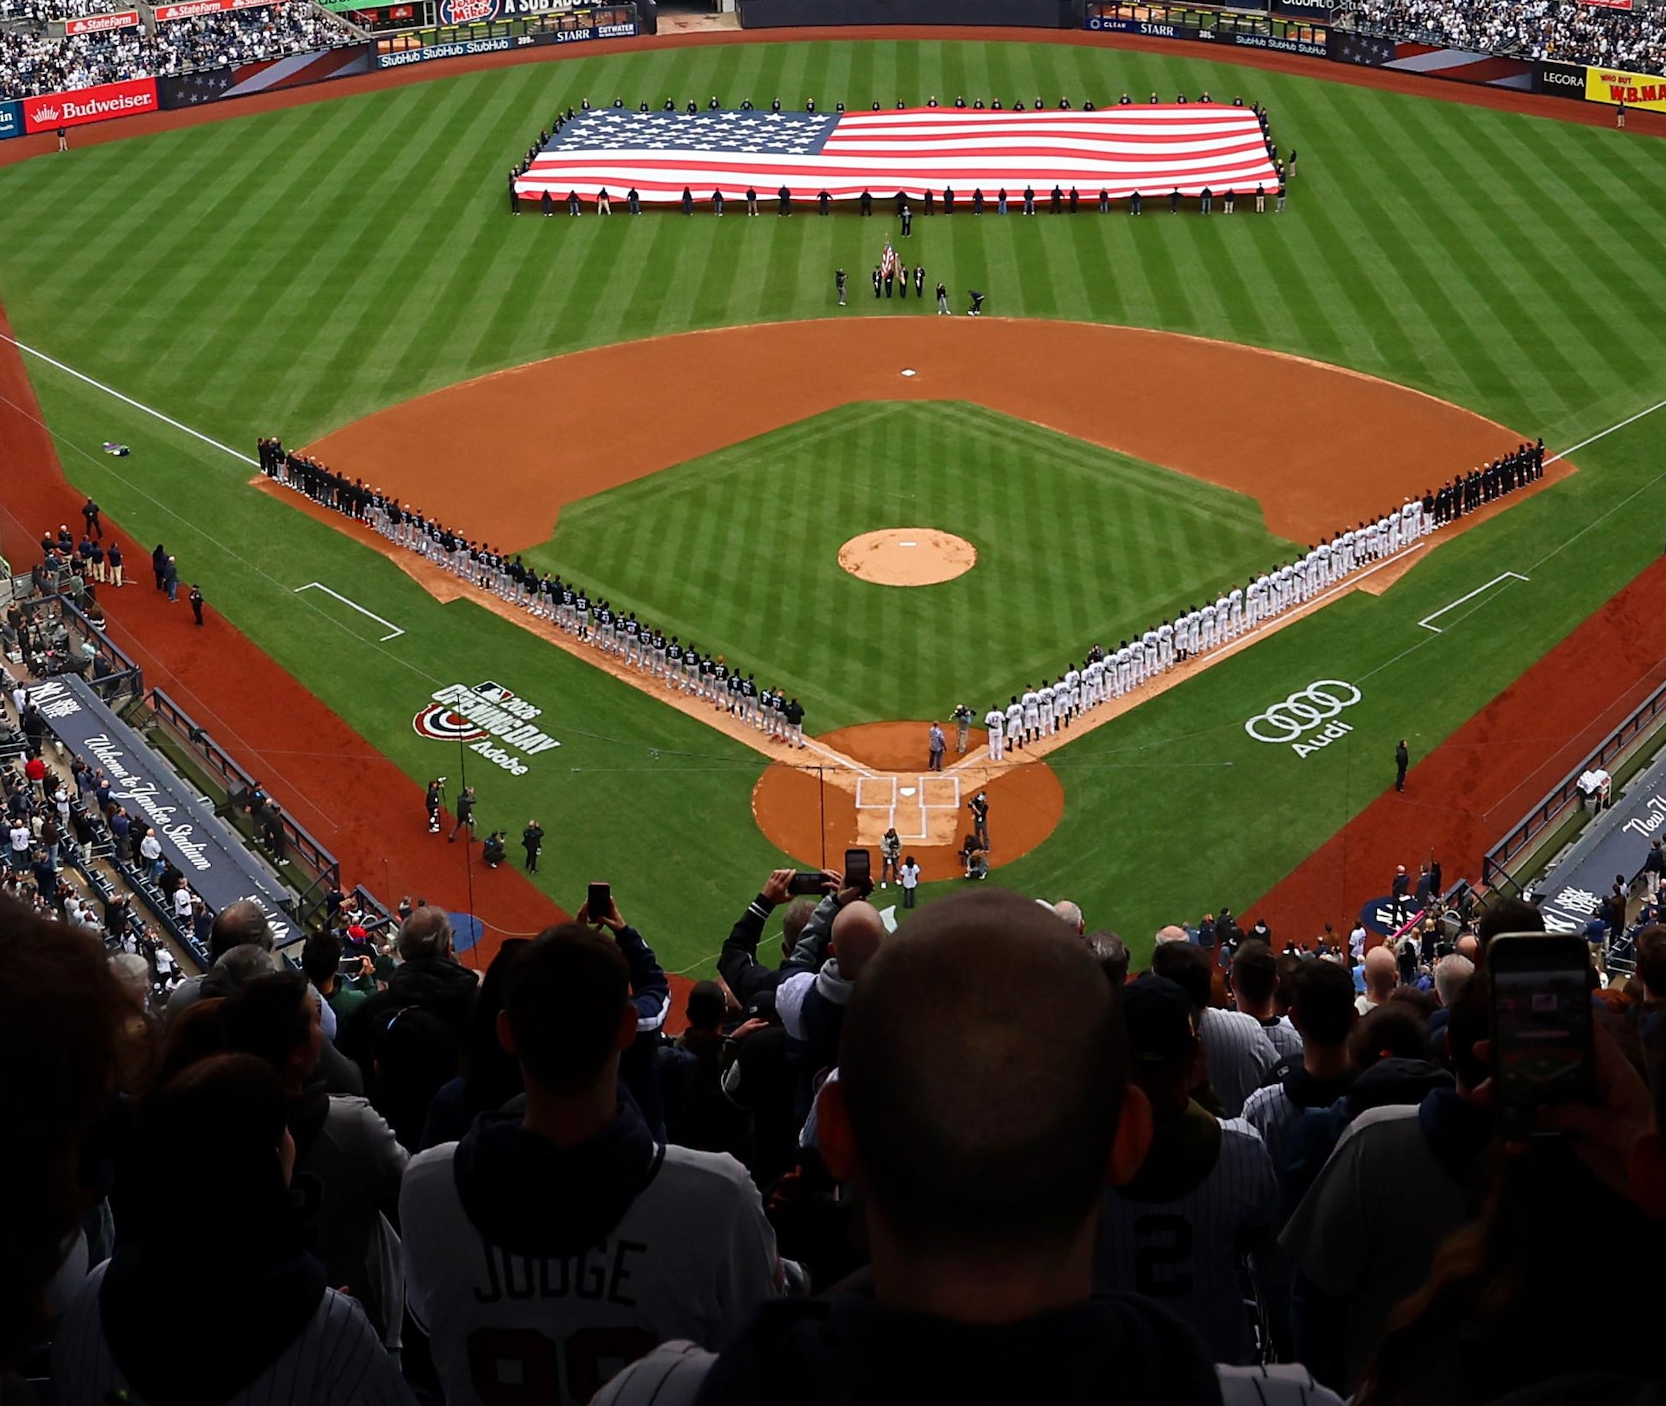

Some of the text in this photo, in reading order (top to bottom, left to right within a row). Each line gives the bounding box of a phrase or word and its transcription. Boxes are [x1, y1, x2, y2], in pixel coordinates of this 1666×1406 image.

[557, 29, 590, 42] STARR
[598, 24, 635, 34] CUTWATER
[1103, 21, 1126, 29] CLEAR
[1140, 23, 1174, 36] STARR
[381, 39, 509, 67] StubHub StubHub StubHub
[1236, 35, 1327, 56] StubHub StubHub StubHub
[1543, 71, 1585, 88] LEGORA
[1600, 74, 1616, 83] WHO
[431, 683, 562, 756] OPENING DAY
[499, 697, 543, 721] 2026
[1291, 720, 1354, 759] Audi
[468, 740, 529, 776] Adobe
[83, 733, 213, 871] Welcome to Yankee Stadium
[1622, 807, 1666, 838] New
[474, 1239, 648, 1307] JUDGE
